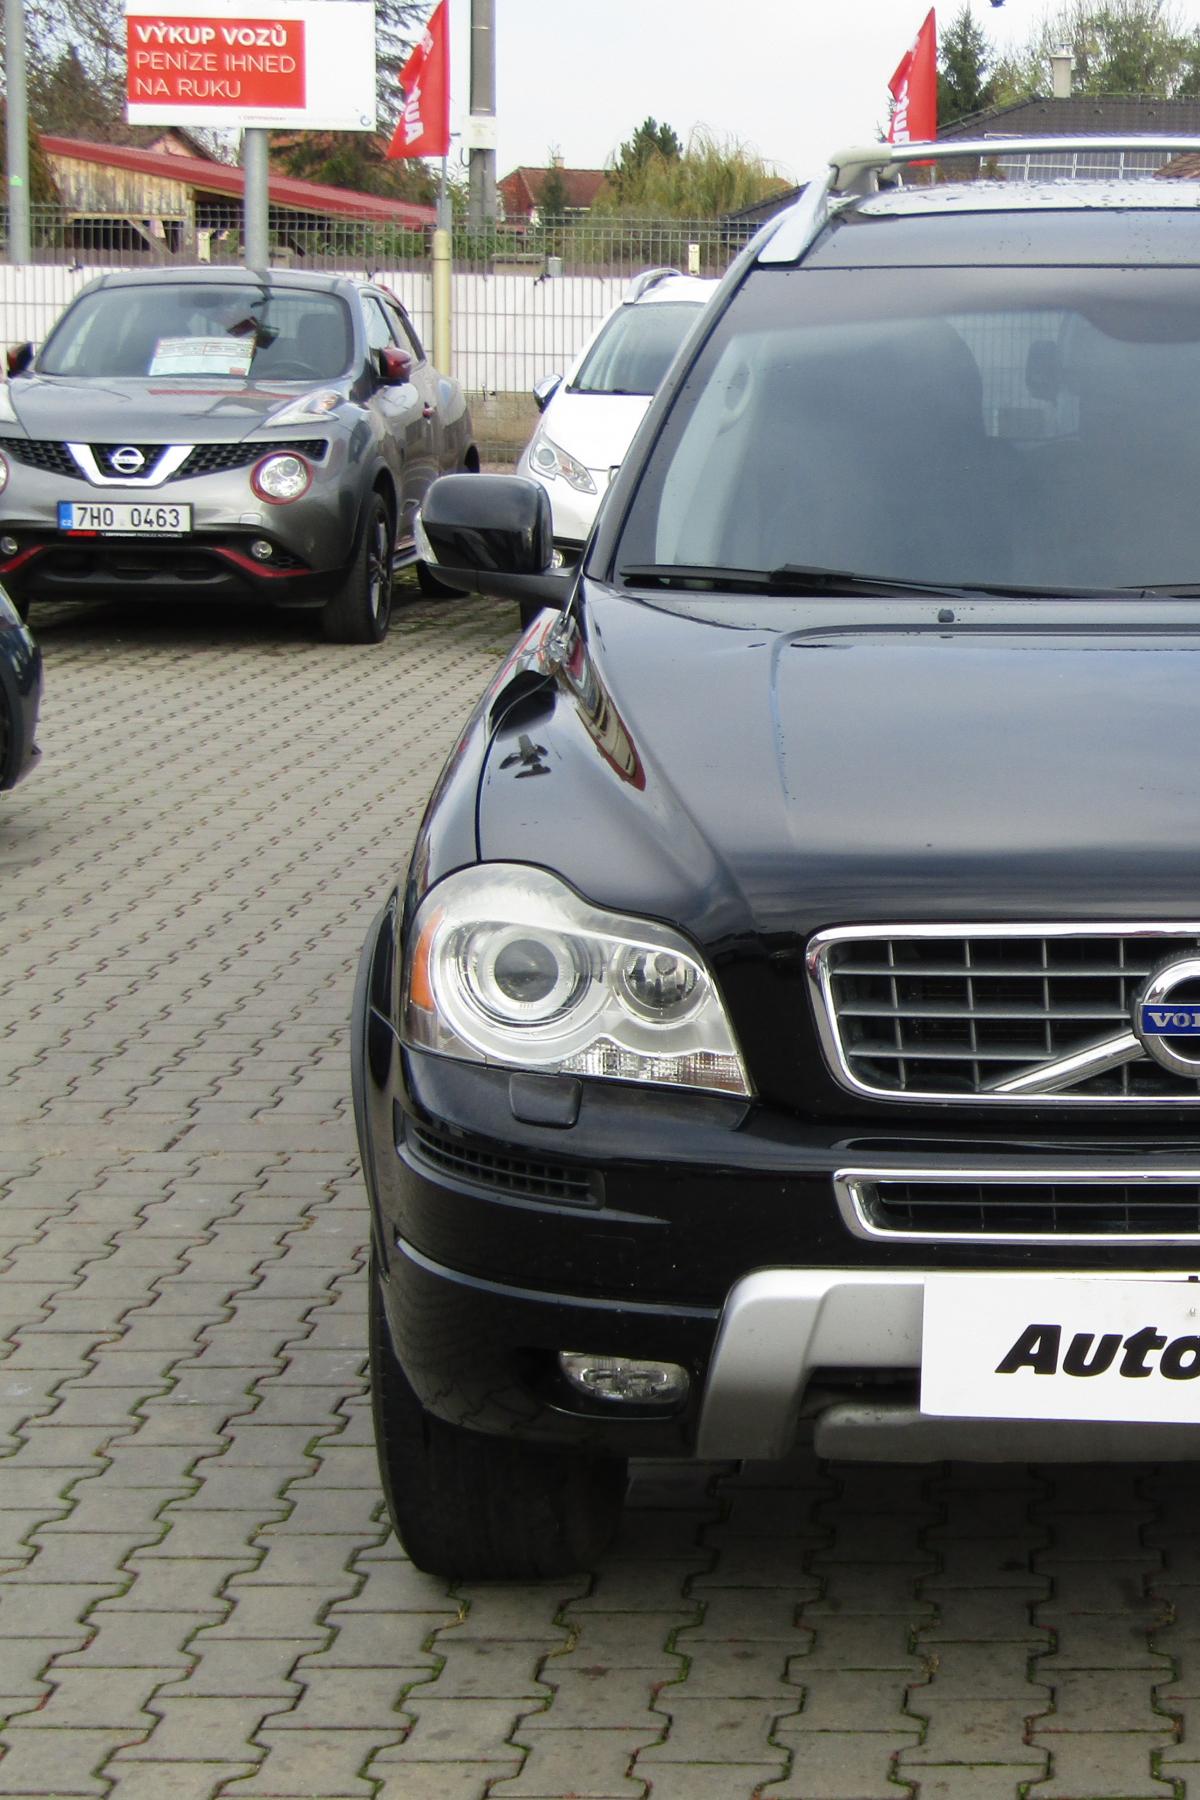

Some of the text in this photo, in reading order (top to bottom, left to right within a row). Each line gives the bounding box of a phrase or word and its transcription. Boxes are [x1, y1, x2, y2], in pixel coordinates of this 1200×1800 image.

[136, 22, 288, 47] VÝKUP VOZŮ
[136, 50, 297, 74] PENÍZE IHNED
[136, 78, 242, 98] NA RUKU
[77, 507, 181, 529] 7H0 0463
